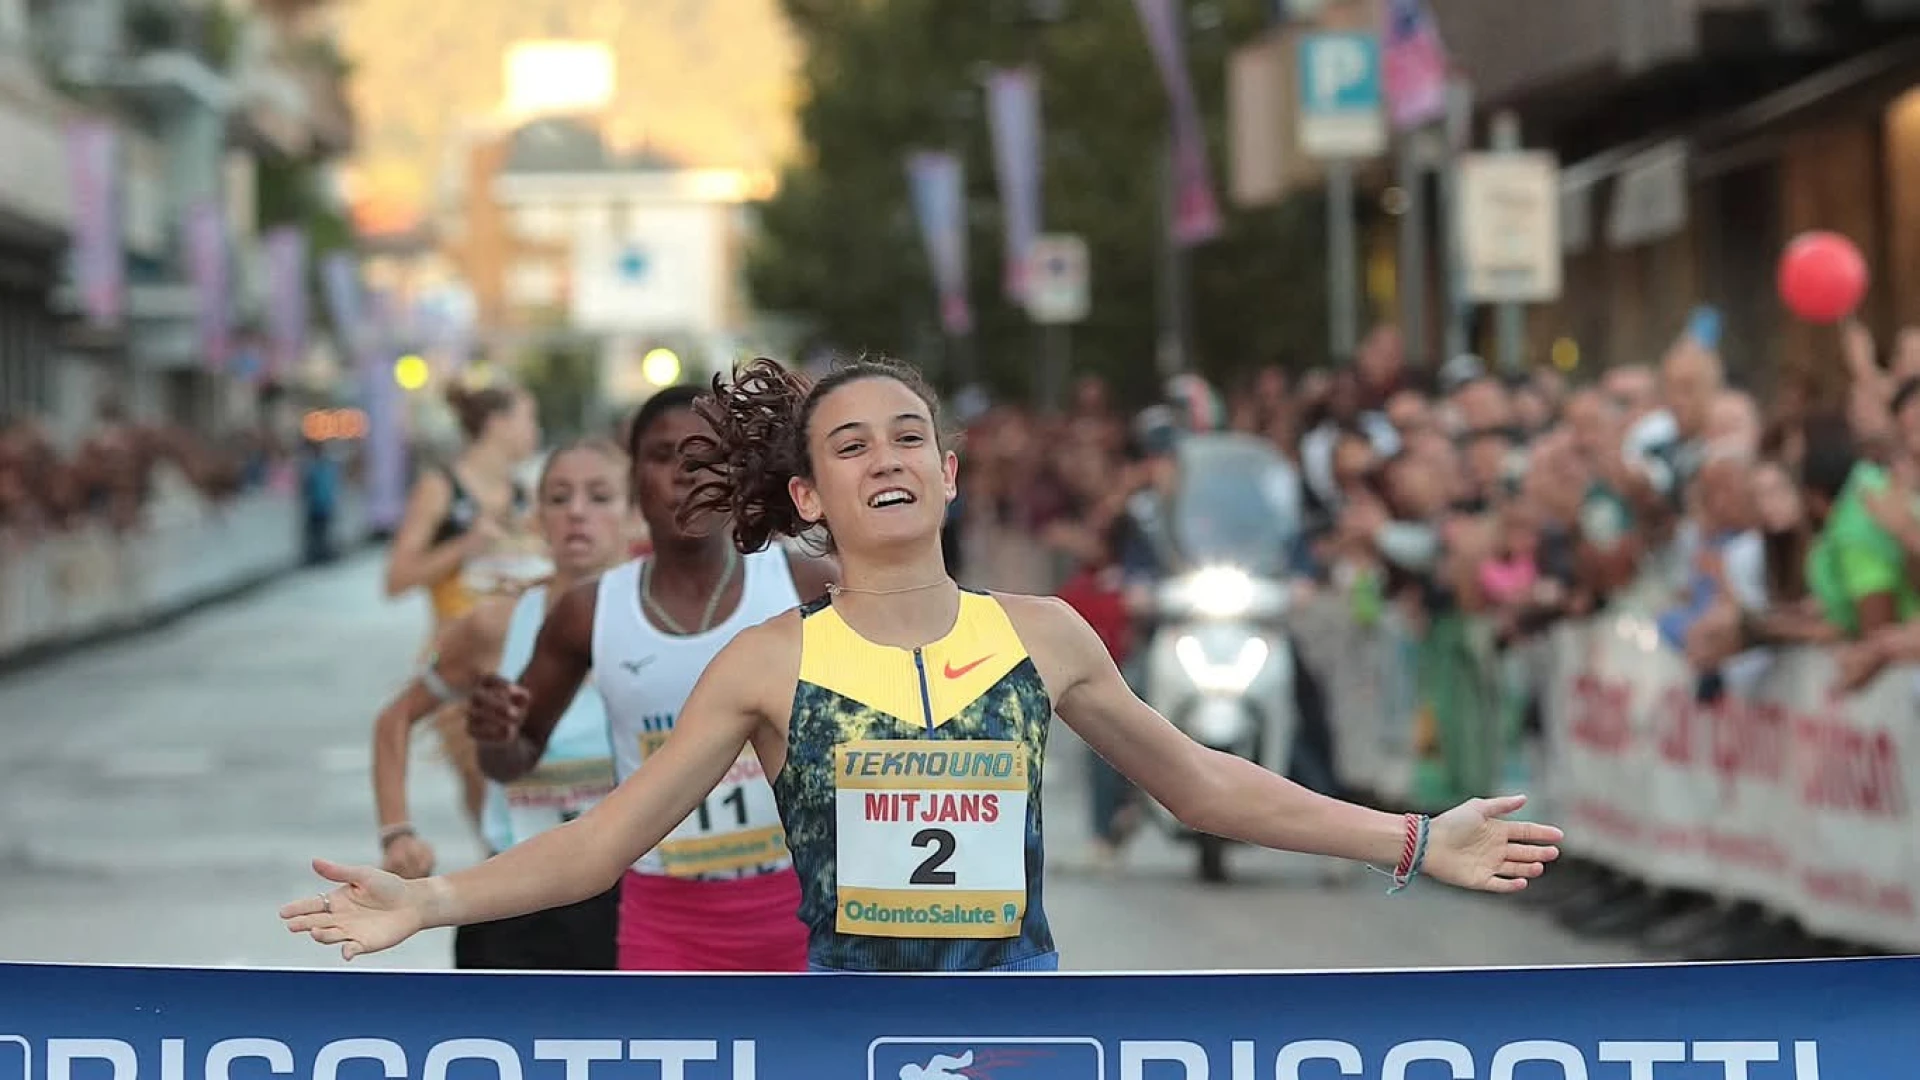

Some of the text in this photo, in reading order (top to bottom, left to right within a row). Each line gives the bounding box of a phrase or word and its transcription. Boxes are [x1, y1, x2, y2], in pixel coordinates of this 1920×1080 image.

[1311, 38, 1366, 105] P
[844, 751, 1013, 777] TEKNOUNO
[865, 793, 999, 822] MITJANS
[909, 827, 956, 885] 2
[844, 900, 996, 924] OdontoSalute
